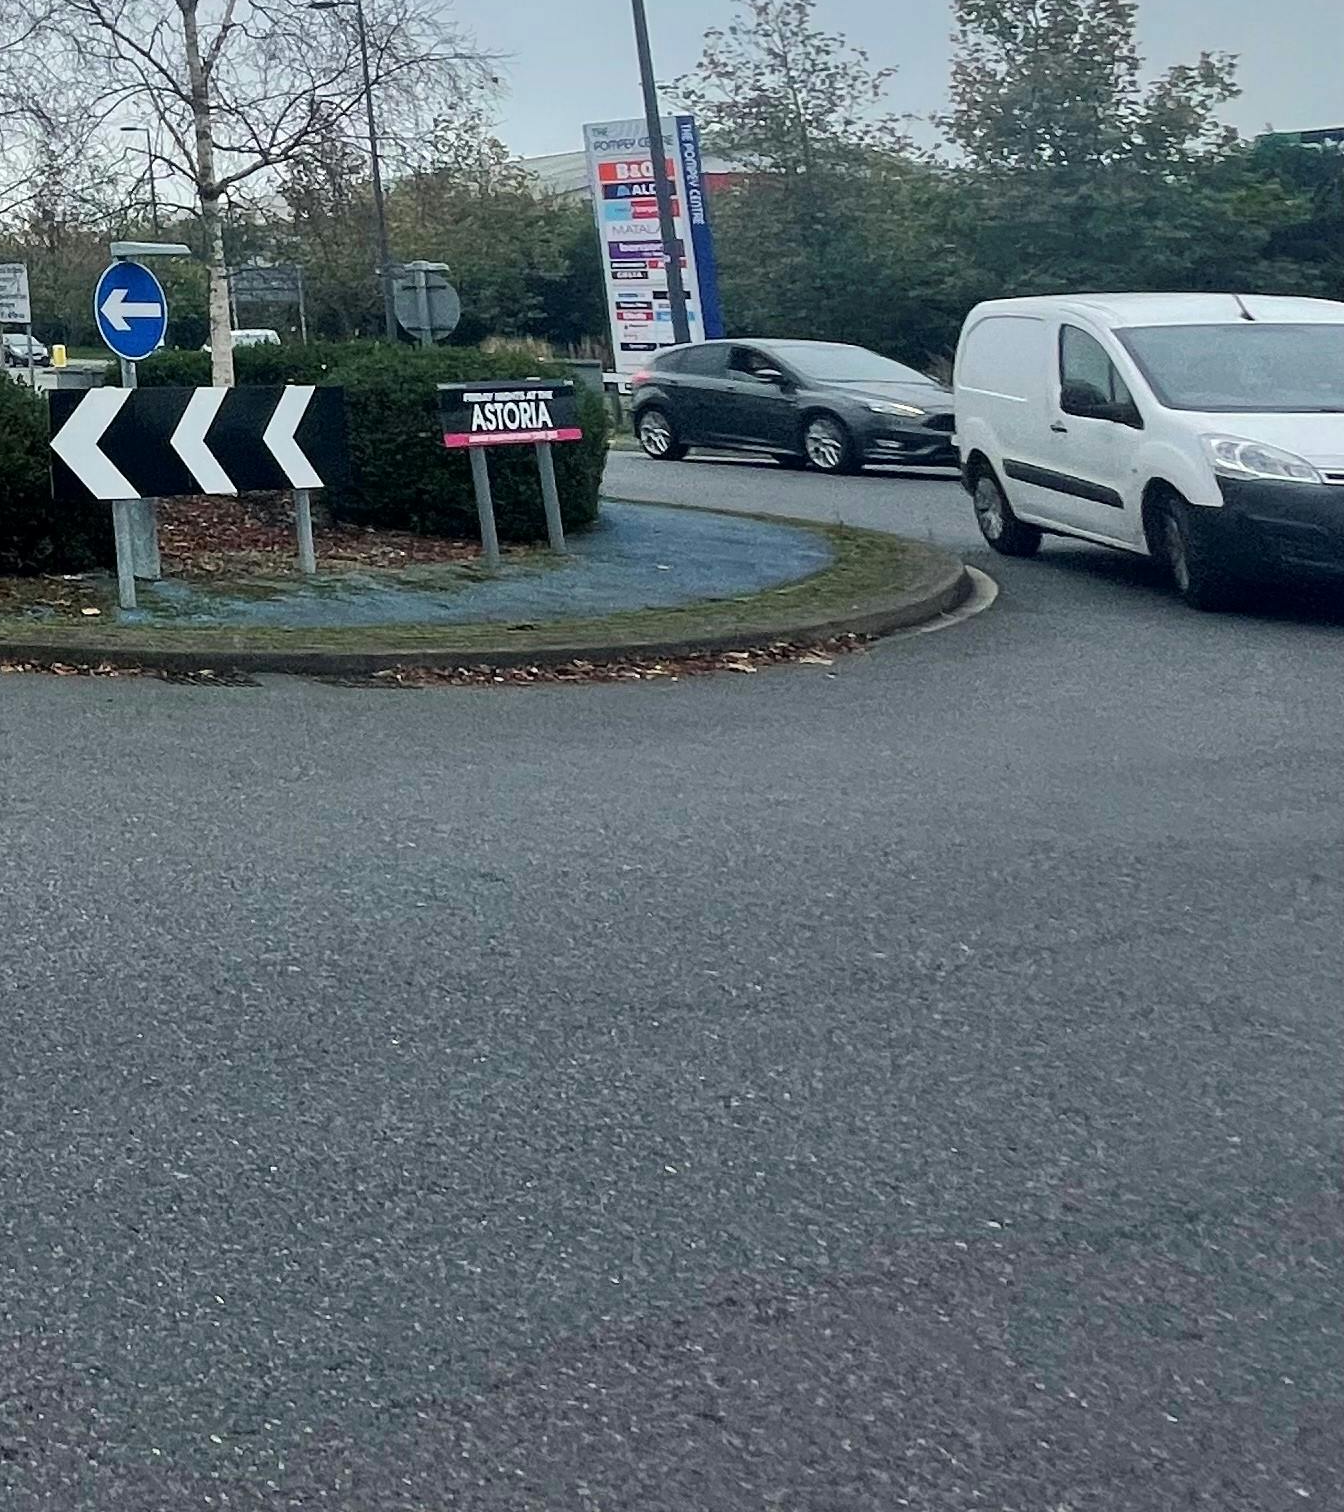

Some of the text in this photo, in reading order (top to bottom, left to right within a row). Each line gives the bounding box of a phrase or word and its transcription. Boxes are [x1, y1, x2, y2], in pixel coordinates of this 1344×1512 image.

[680, 124, 694, 143] THE
[616, 161, 654, 179] B&Q
[632, 183, 657, 197] ALD
[472, 401, 553, 431] ASTORIA
